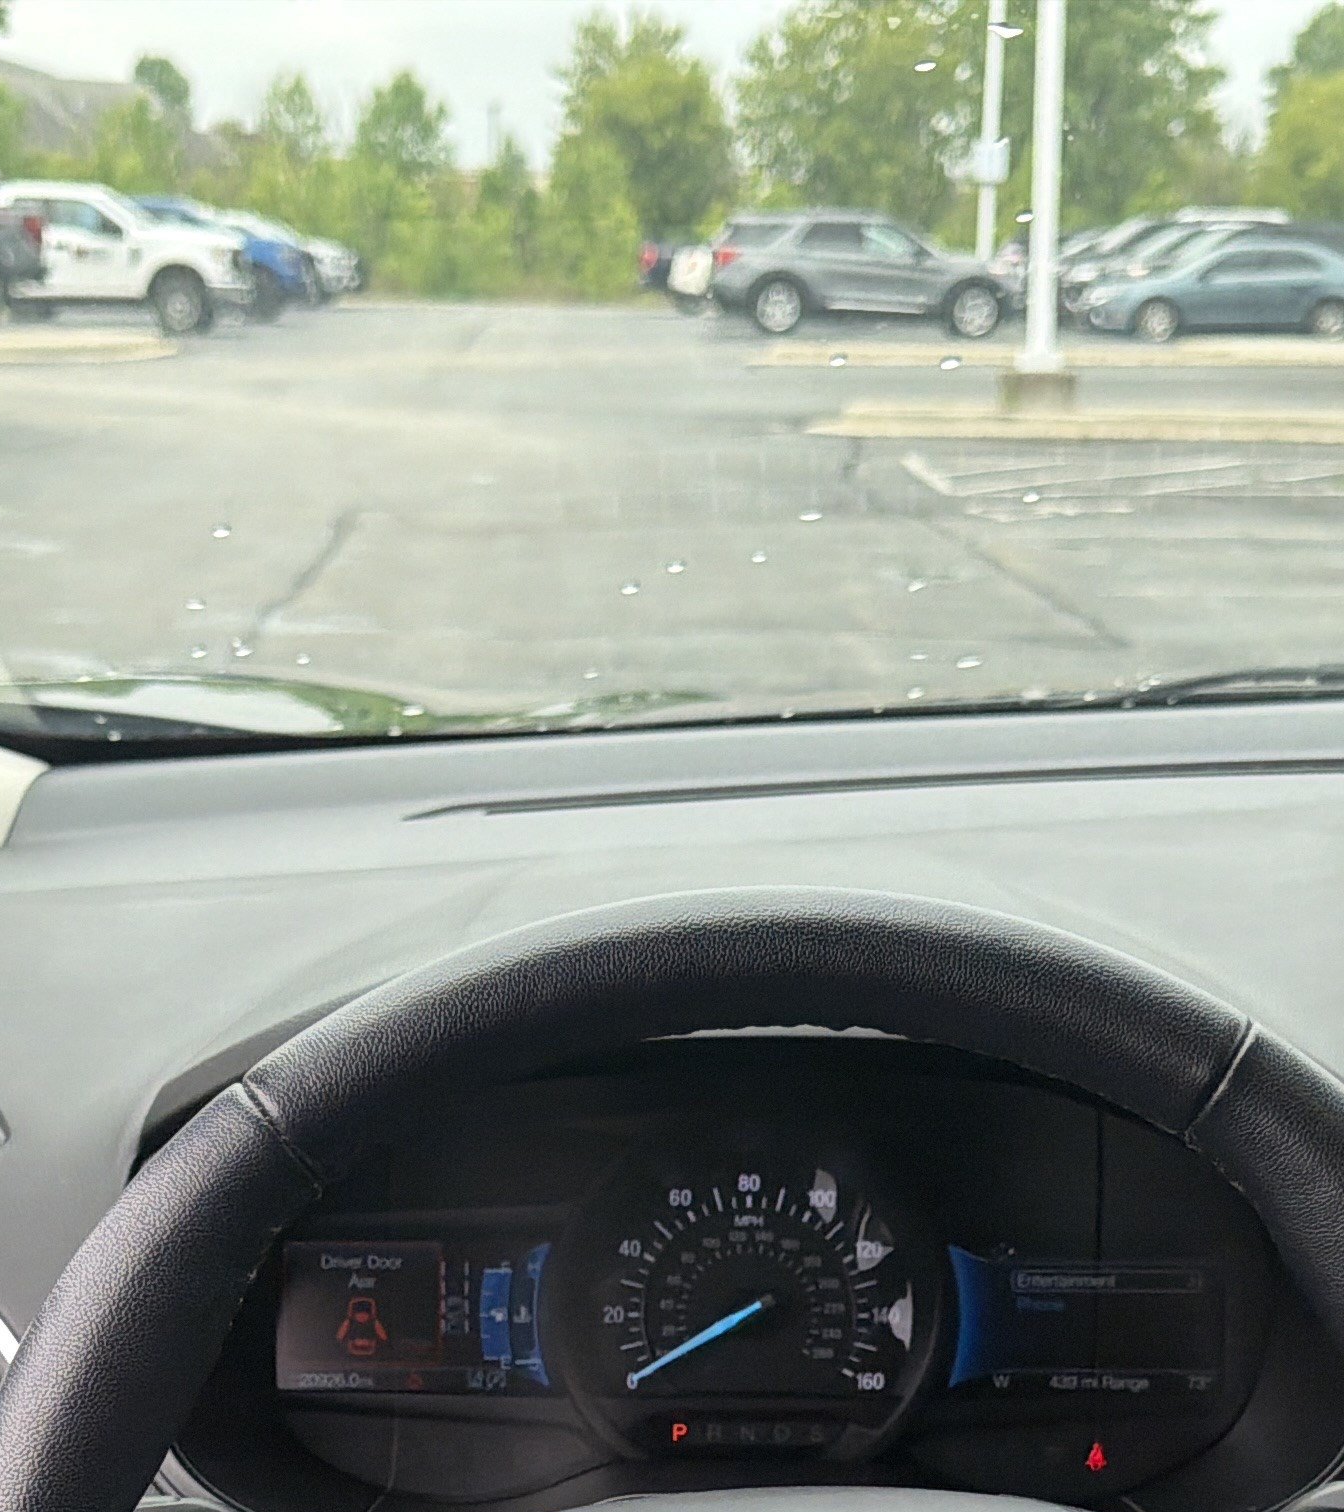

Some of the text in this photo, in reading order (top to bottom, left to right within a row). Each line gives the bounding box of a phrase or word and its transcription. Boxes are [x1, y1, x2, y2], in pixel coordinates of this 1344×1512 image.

[738, 1174, 761, 1192] 80
[669, 1189, 692, 1207] 60
[809, 1190, 837, 1207] 100
[734, 1215, 764, 1226] MPH
[619, 1240, 641, 1257] 40
[856, 1241, 882, 1258] 120
[367, 1254, 402, 1270] Door
[603, 1306, 624, 1323] 20
[856, 1372, 885, 1390] 160
[1102, 1375, 1149, 1392] Range
[672, 1423, 687, 1441] P
